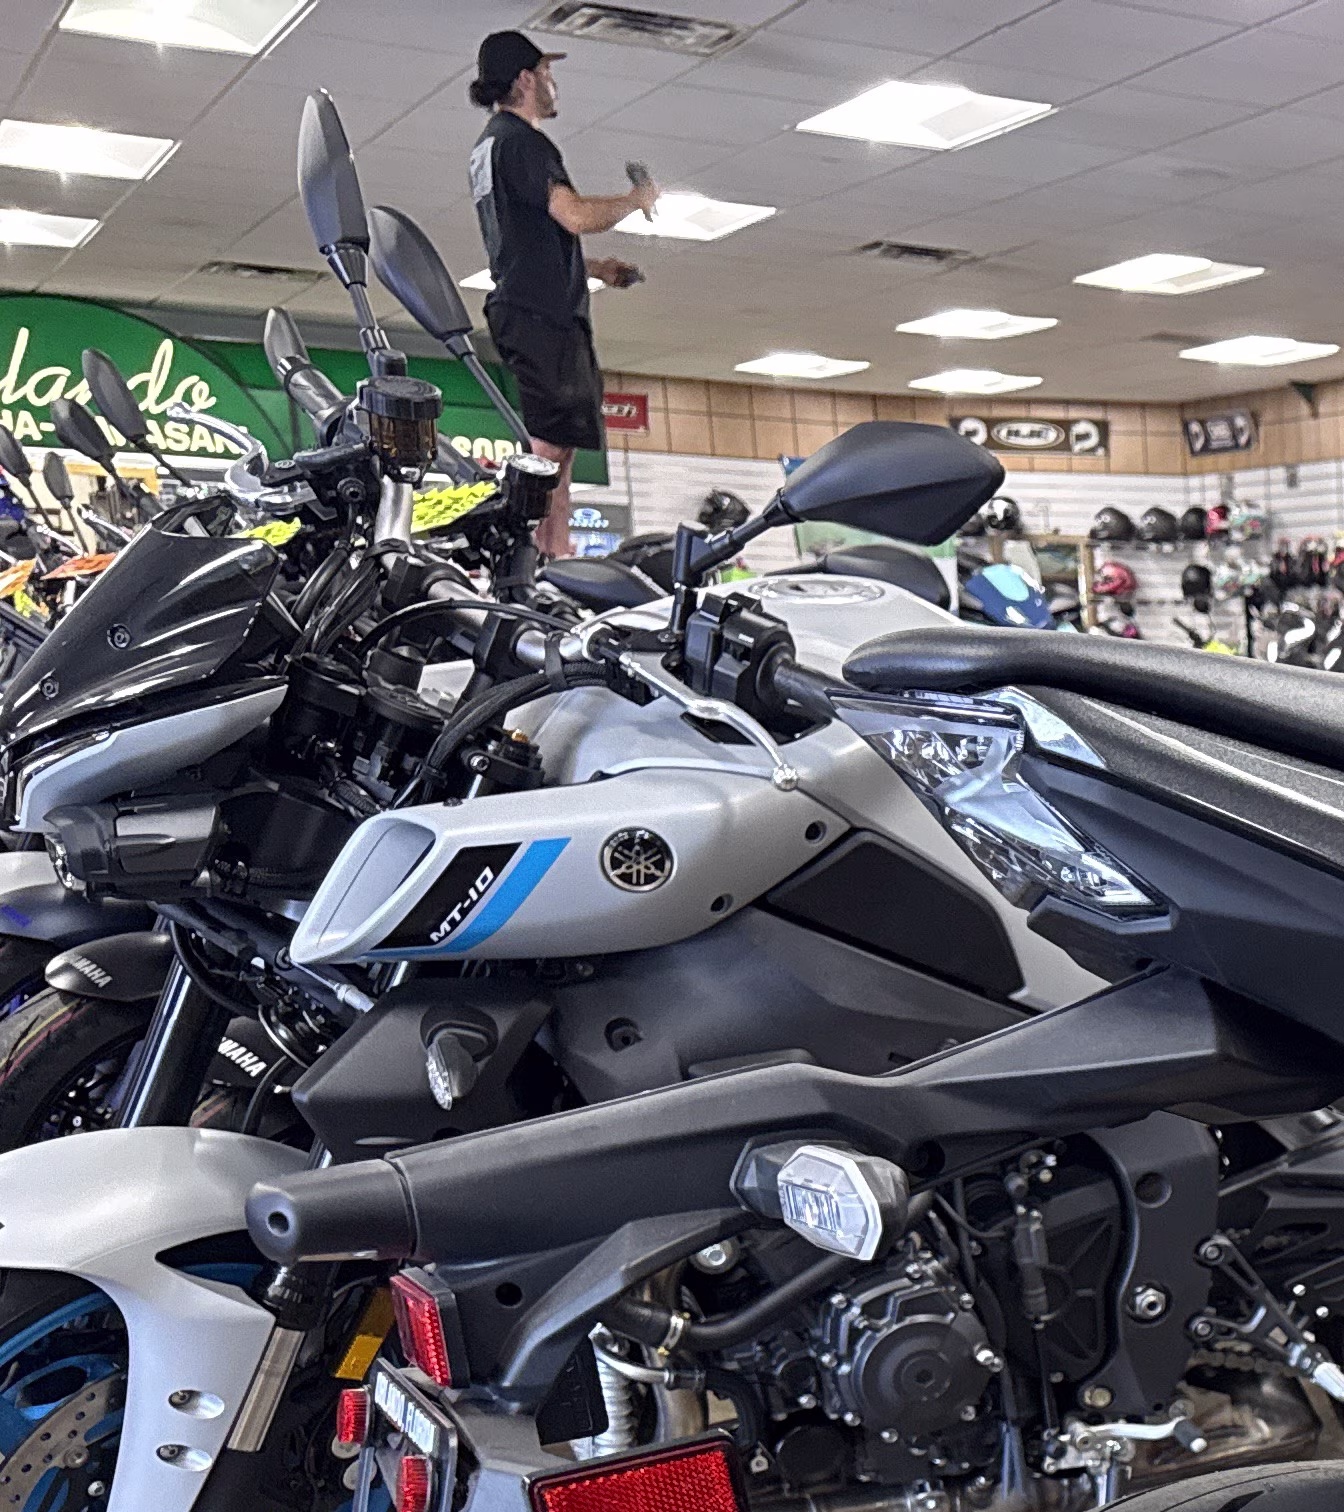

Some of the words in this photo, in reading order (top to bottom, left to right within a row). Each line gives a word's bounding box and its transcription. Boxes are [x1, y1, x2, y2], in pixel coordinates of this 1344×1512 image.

[0, 327, 217, 416] lado
[429, 865, 495, 943] MT-10
[217, 1036, 268, 1078] MAHA
